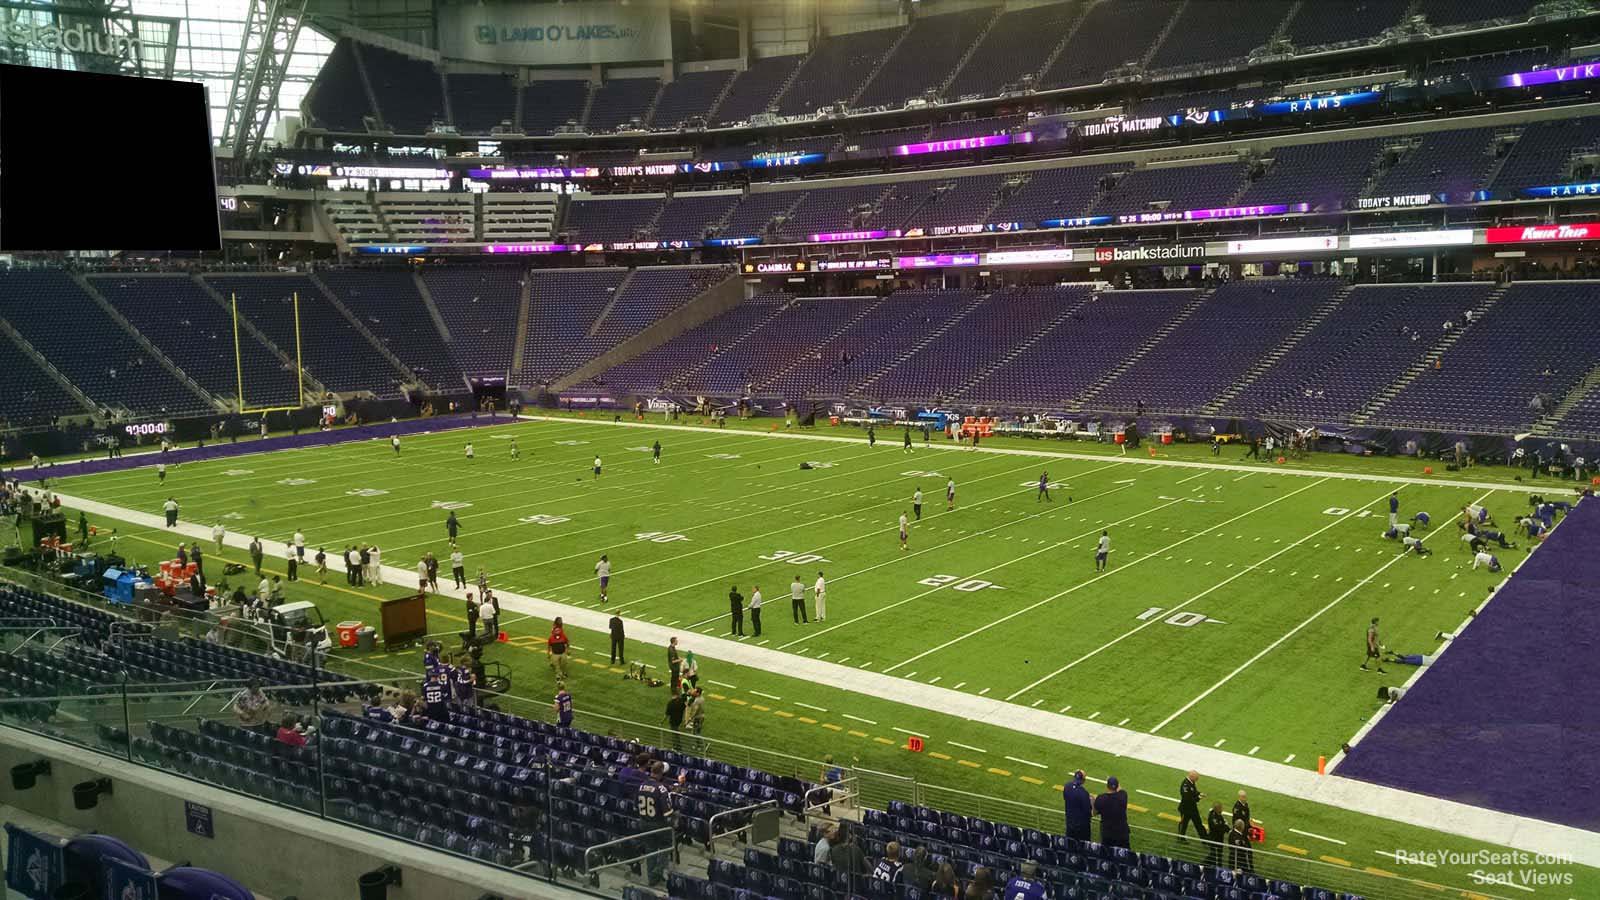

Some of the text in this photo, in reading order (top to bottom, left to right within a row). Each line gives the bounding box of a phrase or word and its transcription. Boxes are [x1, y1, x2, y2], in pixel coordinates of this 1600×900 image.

[5, 21, 145, 56] stadium
[502, 26, 544, 41] LAND
[1556, 65, 1594, 80] VIK
[1290, 99, 1341, 112] RAMS
[1085, 118, 1162, 136] TODAY'S MATCHUP
[928, 138, 985, 152] VIKINGS
[766, 158, 799, 167] RAMS
[614, 165, 677, 175] TODAY'S MATCHUP
[1551, 186, 1598, 195] RAMS
[220, 198, 236, 210] 40
[1358, 195, 1430, 208] TODAY'S MATCHUP
[1209, 206, 1265, 217] VIKINGS
[1060, 218, 1090, 227] RAMS
[934, 225, 983, 235] TODAY'S MATCHUP
[635, 241, 658, 249] MATCHUP
[757, 264, 792, 272] CAMBRIA
[758, 550, 824, 564] 30
[916, 574, 993, 592] 20
[1136, 607, 1208, 627] 10
[340, 631, 351, 641] G
[427, 691, 442, 703] 52
[910, 739, 920, 750] 10
[638, 795, 656, 817] 26
